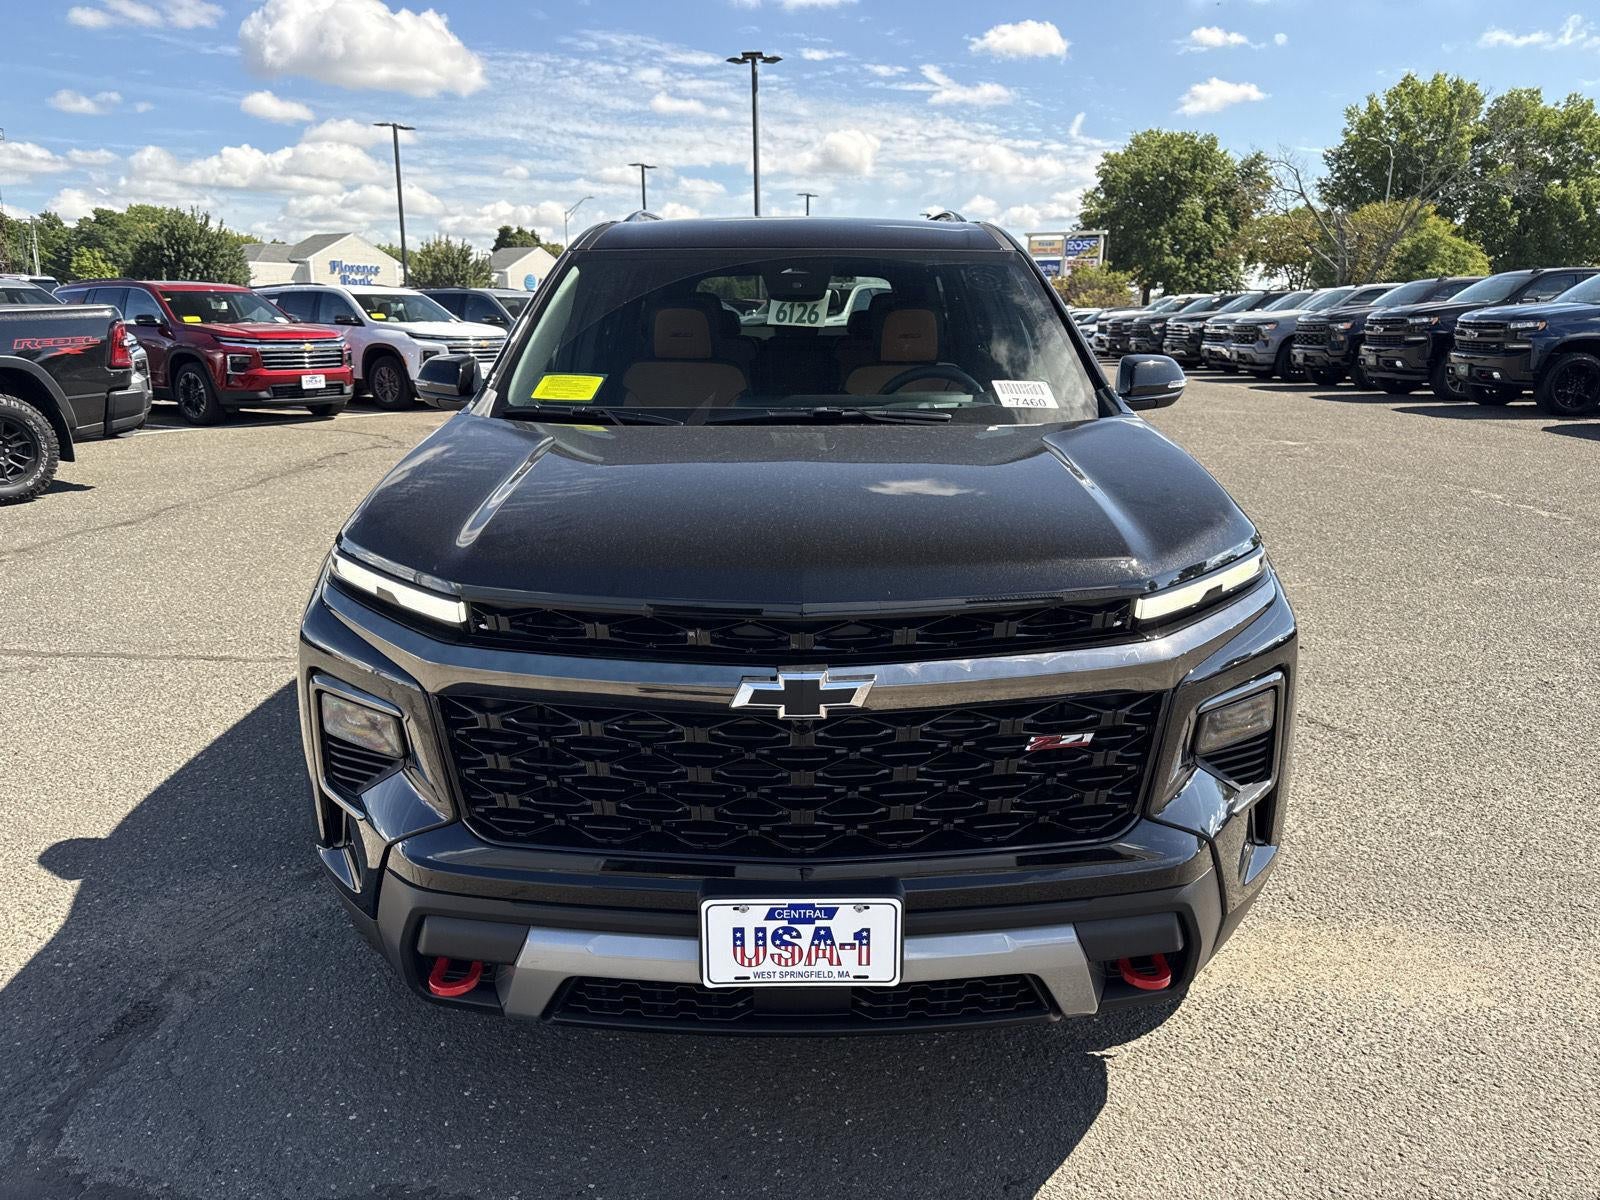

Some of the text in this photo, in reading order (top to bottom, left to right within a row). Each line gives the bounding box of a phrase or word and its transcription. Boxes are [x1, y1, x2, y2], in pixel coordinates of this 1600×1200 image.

[329, 260, 380, 274] Florence
[340, 274, 373, 285] Bank
[776, 303, 819, 324] 6126
[13, 336, 101, 349] REBEL
[1025, 733, 1095, 751] Z71
[774, 909, 828, 919] CENTRAL
[732, 926, 871, 967] USA-1
[752, 970, 850, 980] WEST SPRINGFIELD, MA
